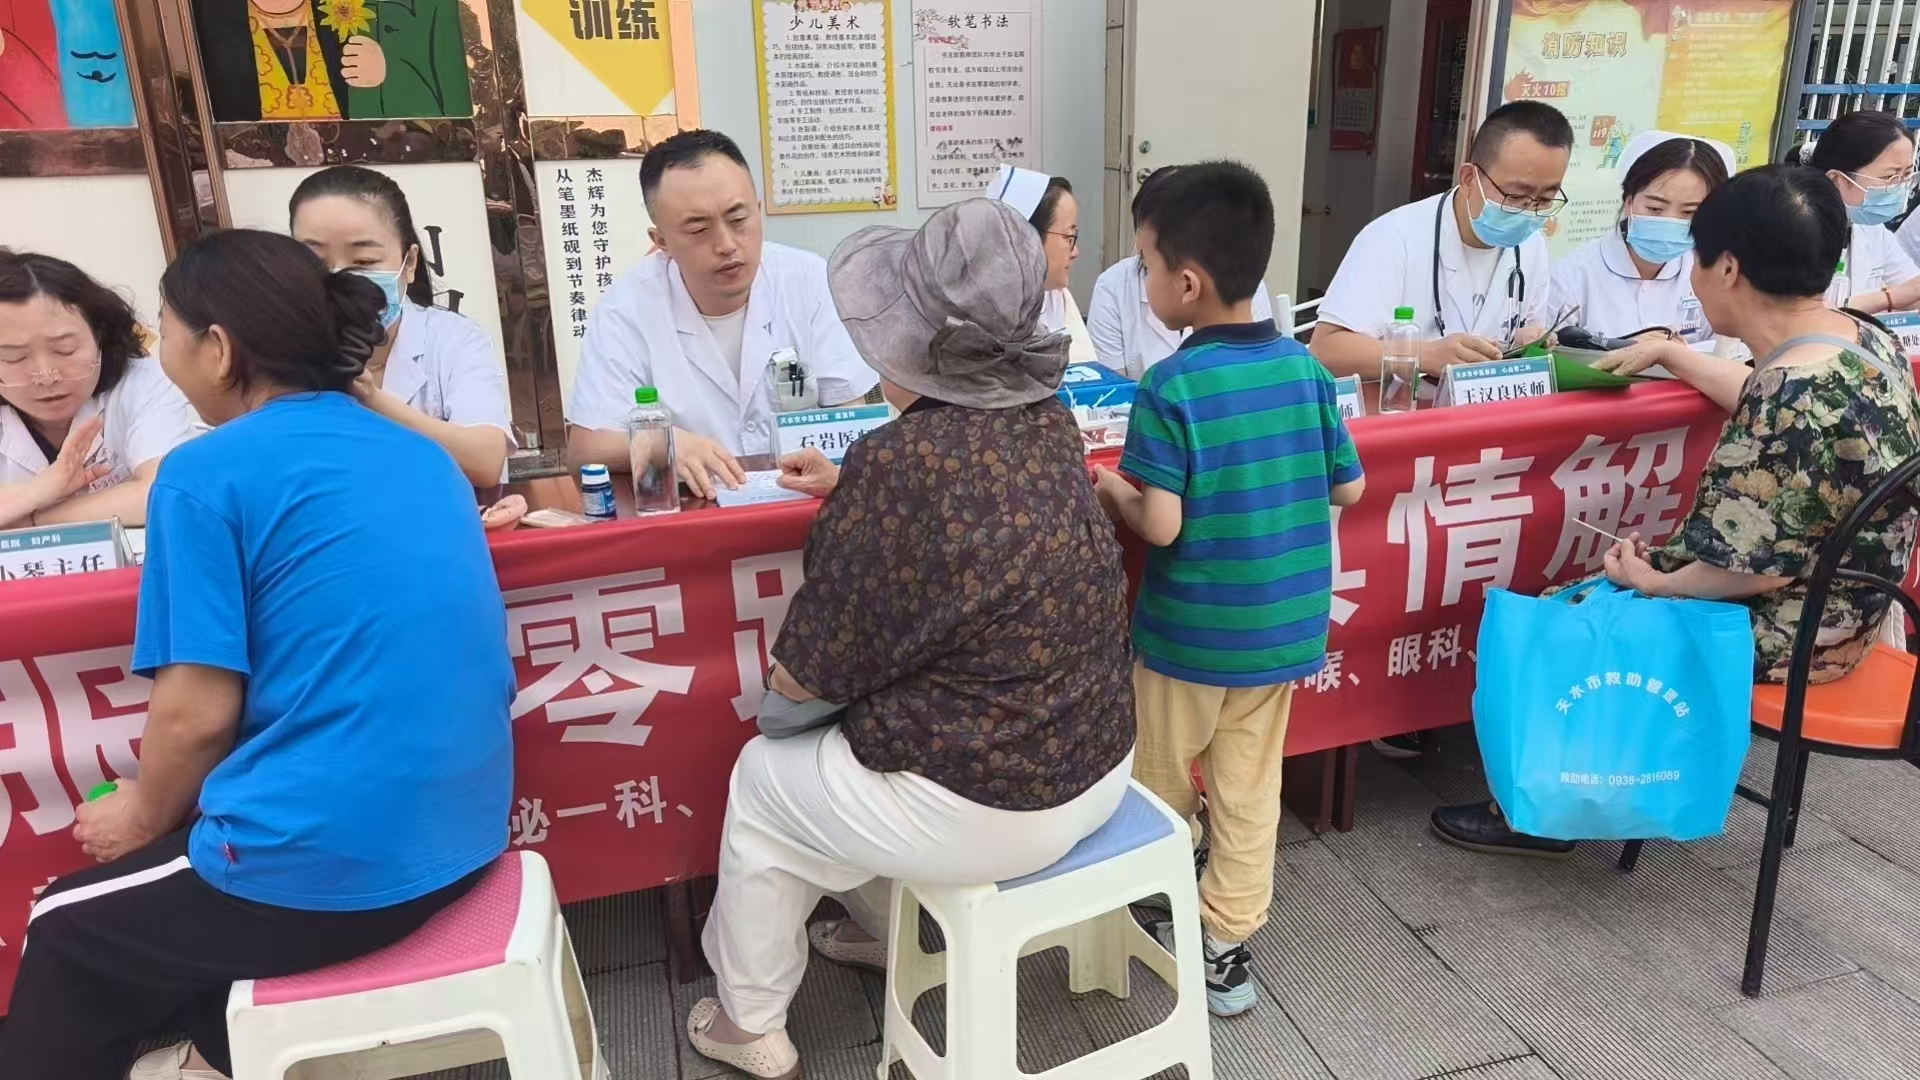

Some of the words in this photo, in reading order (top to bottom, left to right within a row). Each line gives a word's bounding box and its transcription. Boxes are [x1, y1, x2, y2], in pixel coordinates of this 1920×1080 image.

[570, 0, 660, 40] 训练
[789, 15, 861, 31] 少儿美术
[947, 14, 1009, 29] 软笔书法
[1541, 32, 1627, 59] 消防知识
[1521, 83, 1568, 98] 灭火10招
[1592, 127, 1608, 138] 119
[586, 167, 613, 294] 杰辉为您守护孩
[556, 168, 588, 338] 从笔墨纸砚到节奏律动
[1462, 380, 1545, 405] 王汉良医师
[1331, 425, 1690, 626] 情解
[31, 533, 62, 545] 妇产科
[1555, 671, 1691, 718] 天水市救助管理站
